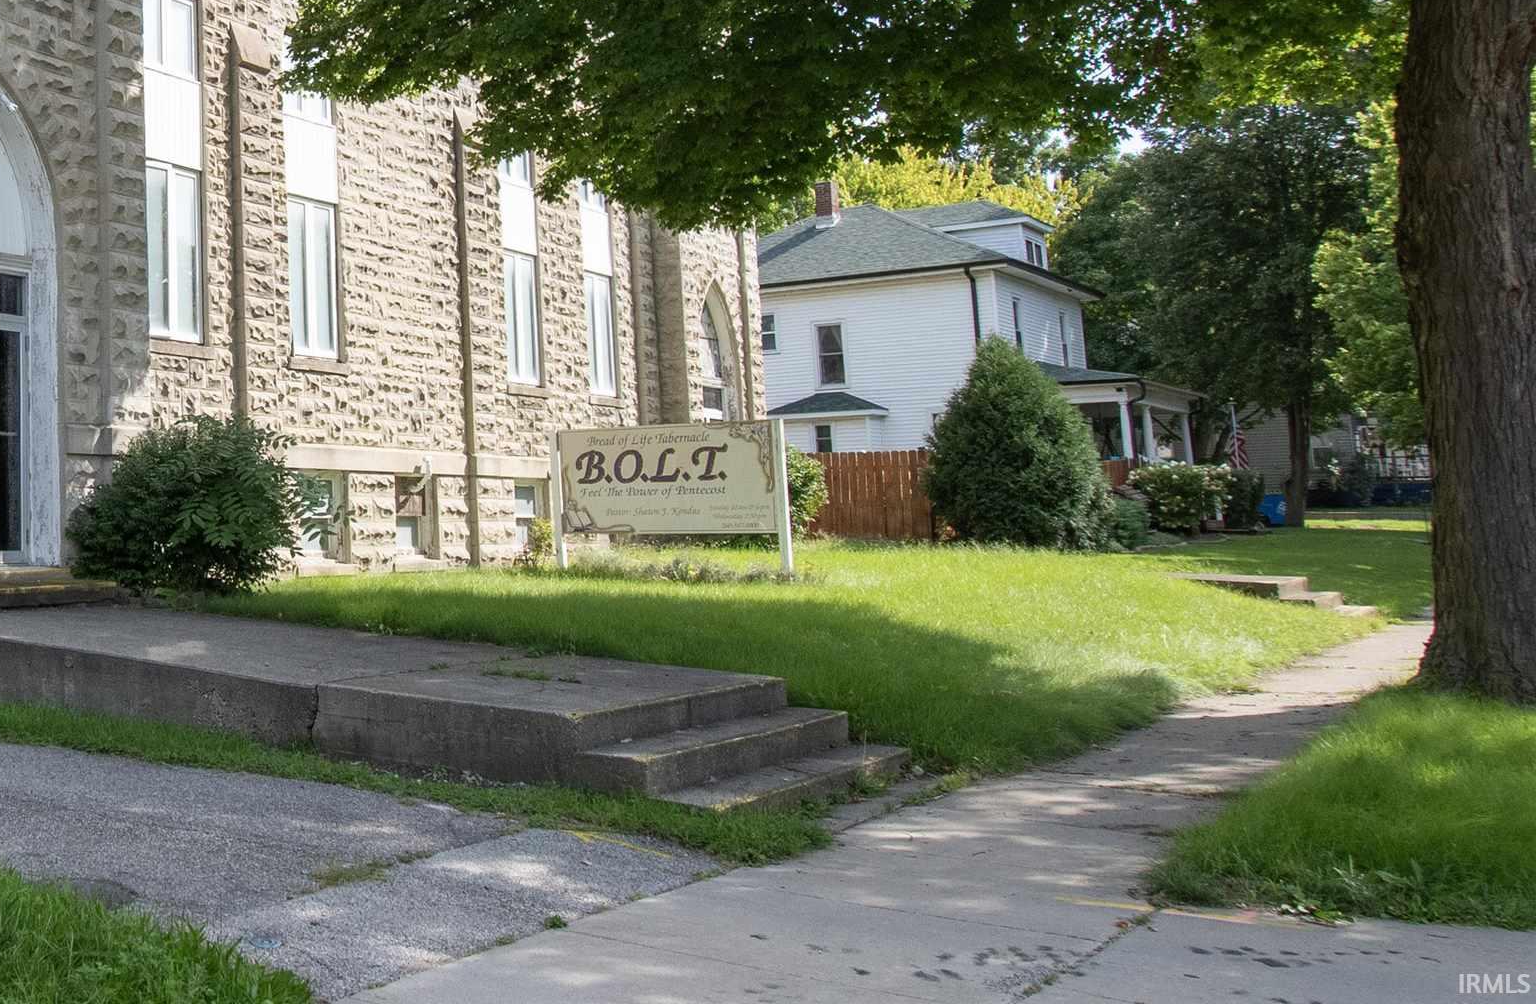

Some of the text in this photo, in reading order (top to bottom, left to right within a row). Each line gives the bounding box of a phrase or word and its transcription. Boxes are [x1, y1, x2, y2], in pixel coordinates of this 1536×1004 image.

[586, 431, 710, 447] Bread of Life Tabernacle
[575, 442, 729, 485] B.O.L.T.
[580, 485, 726, 499] Feel The Power of Pentecost
